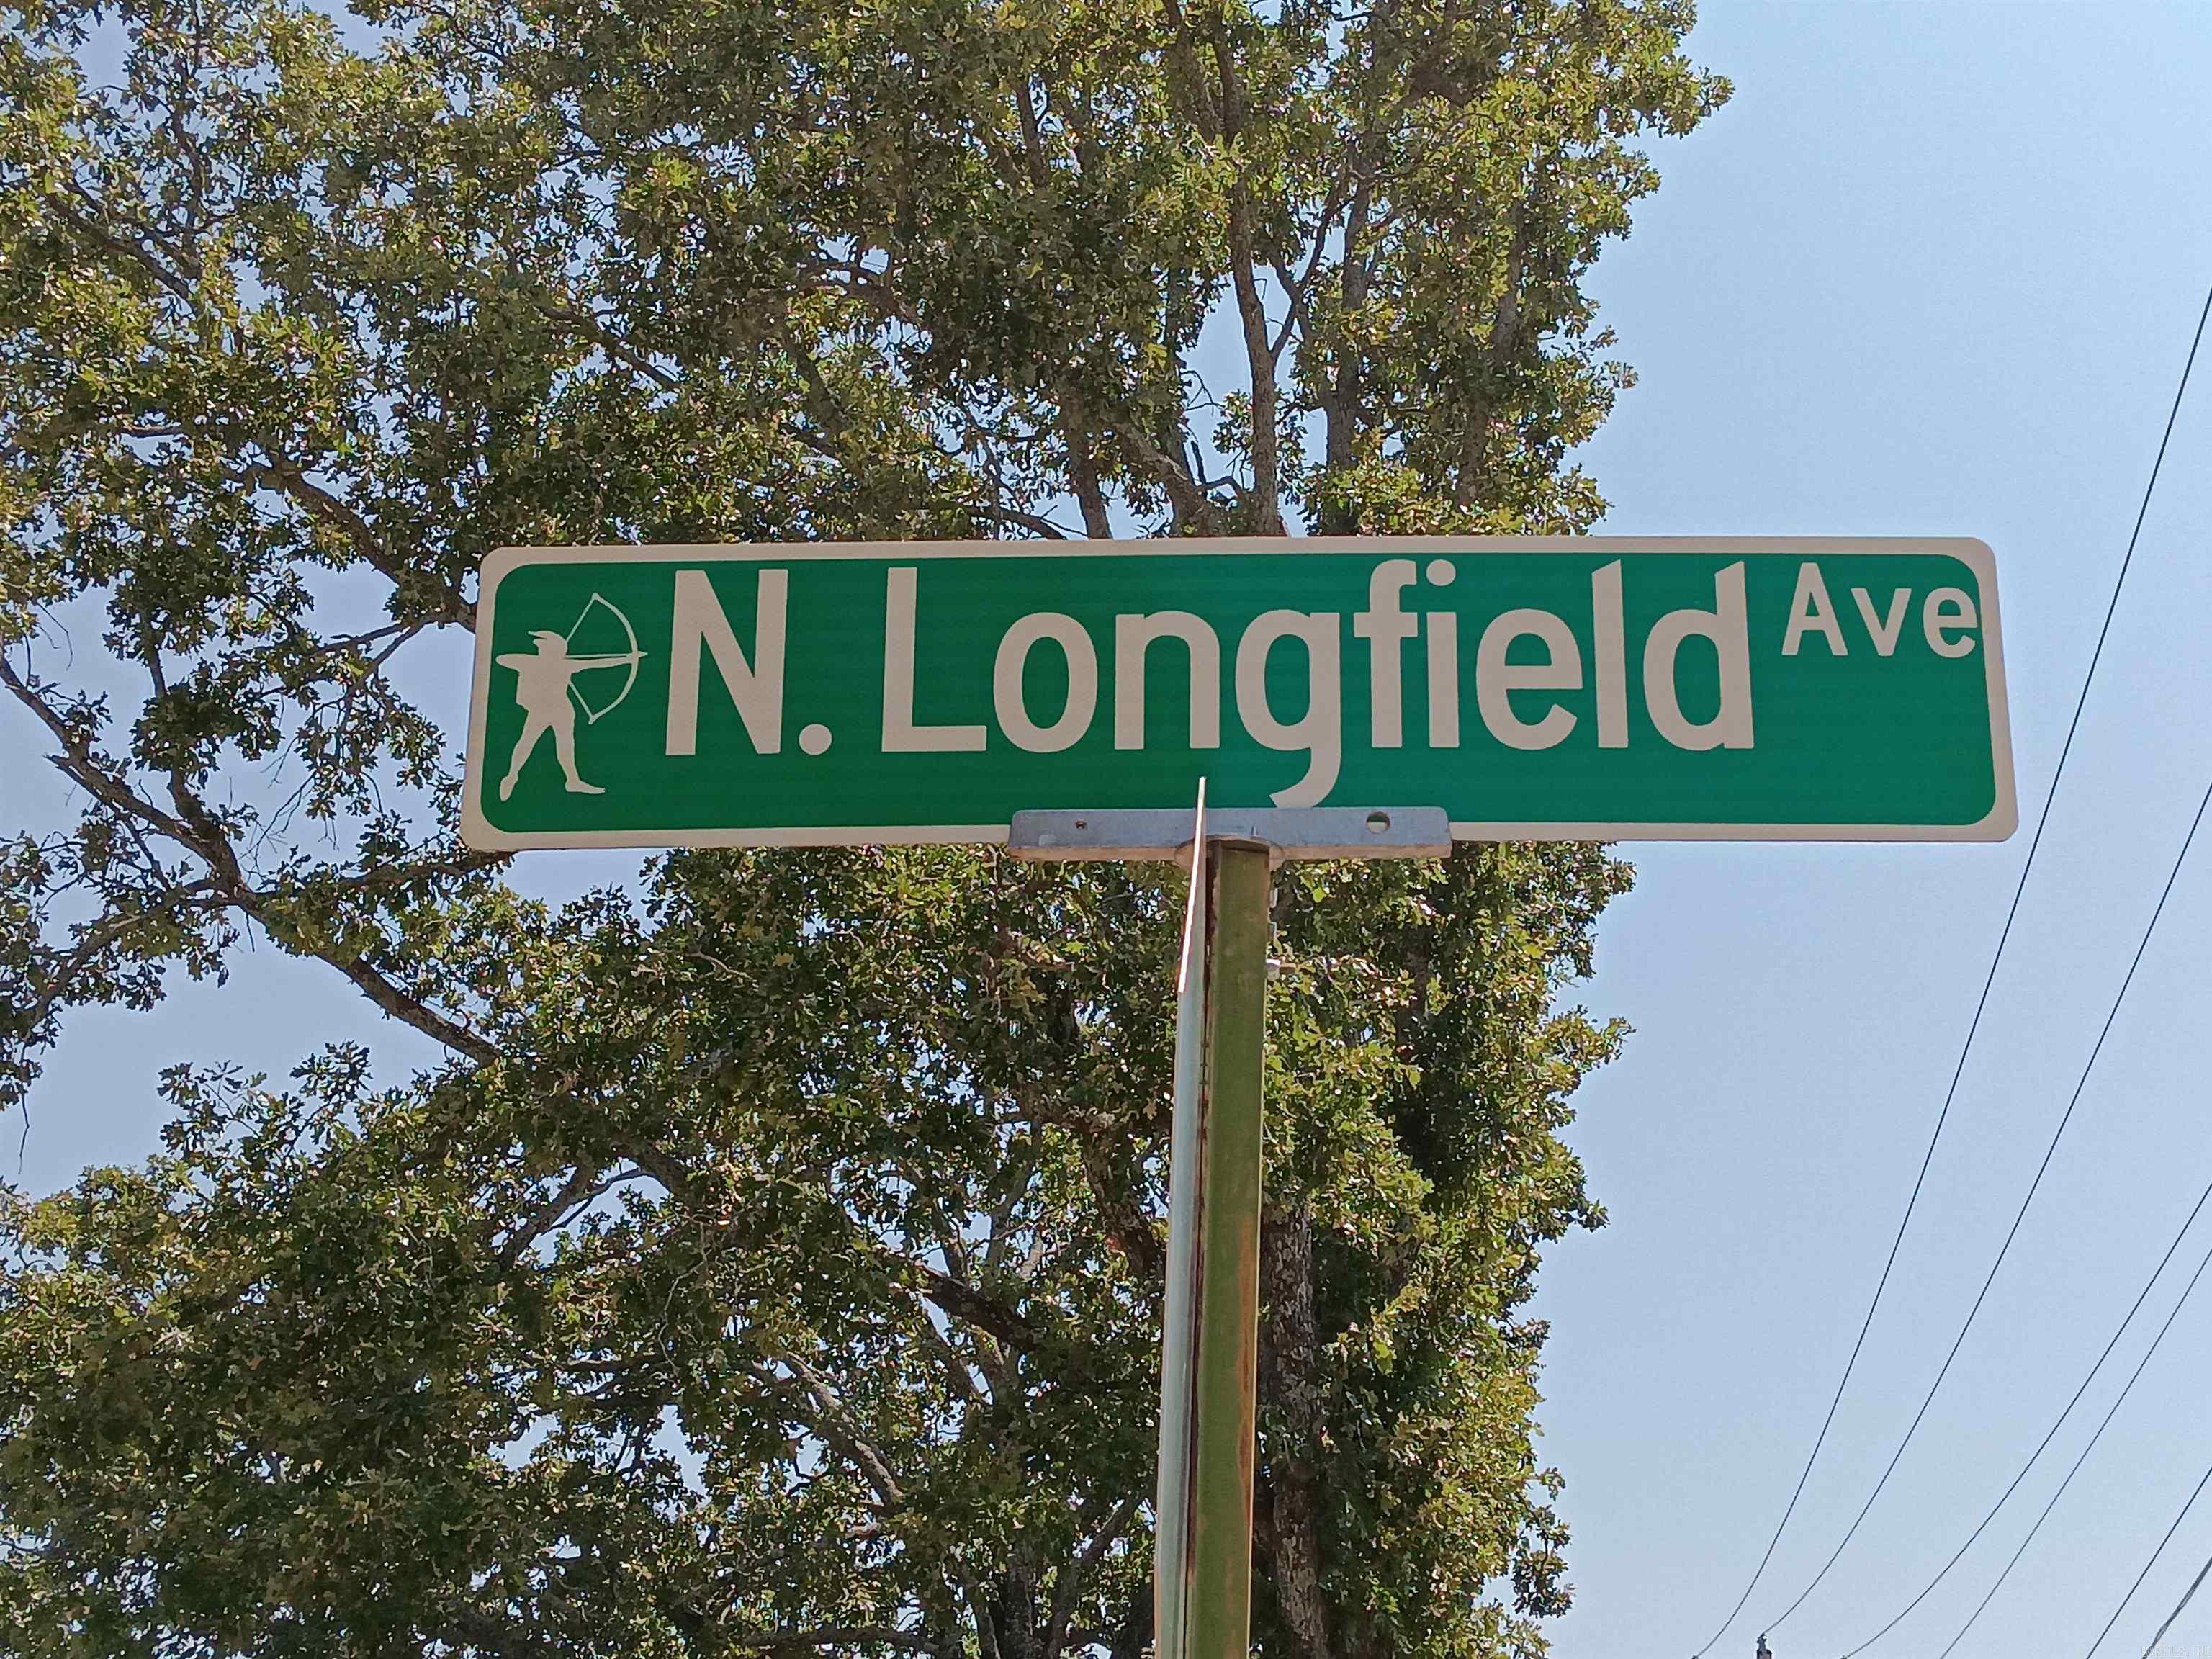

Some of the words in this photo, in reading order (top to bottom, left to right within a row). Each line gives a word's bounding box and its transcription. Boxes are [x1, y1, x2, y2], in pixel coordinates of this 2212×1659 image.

[665, 568, 832, 755] N.
[881, 560, 1754, 807] Longfield
[1781, 562, 1977, 657] Ave
